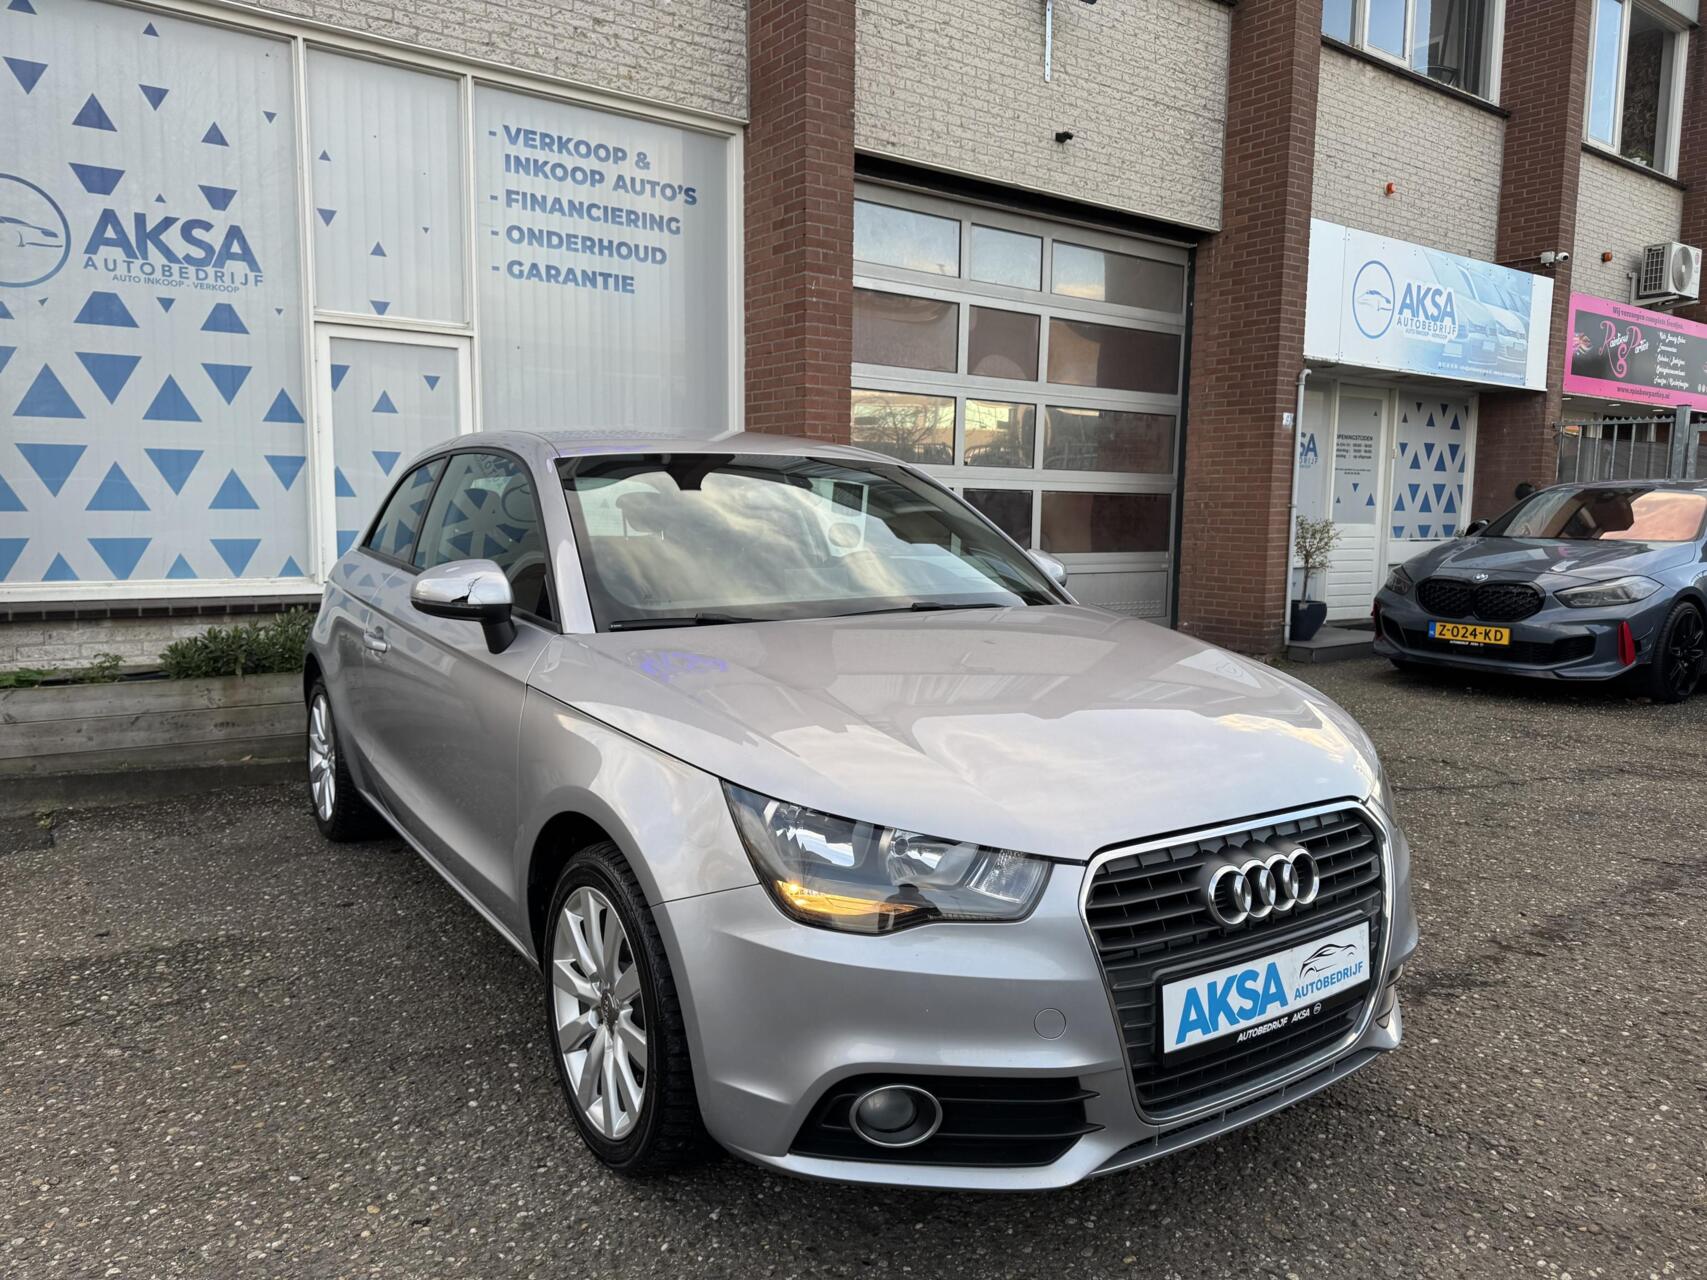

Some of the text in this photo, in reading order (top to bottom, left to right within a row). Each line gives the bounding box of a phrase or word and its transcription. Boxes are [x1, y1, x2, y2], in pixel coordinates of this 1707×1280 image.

[502, 124, 628, 165] VERKOOP
[634, 151, 651, 170] &
[504, 153, 698, 206] INKOOP AUTO'S
[505, 188, 681, 236] FINANCIERING
[84, 207, 262, 273] AKSA
[505, 224, 668, 265] ONDERHOUD
[83, 256, 264, 288] AUTOBEDRIJF
[112, 273, 141, 285] AUTO
[143, 276, 185, 288] INKOOP
[192, 282, 240, 294] VERKOOP
[506, 259, 636, 294] GARANTIE
[1398, 282, 1457, 325] AKSA
[1397, 316, 1457, 336] AUTOBEDRIJF
[1438, 624, 1504, 642] Z-024-KD
[1293, 961, 1364, 1001] AUTOBEDRIJF
[1175, 961, 1289, 1046] AKSA
[1236, 1007, 1310, 1043] AUTOBEDRIJF AKSA
